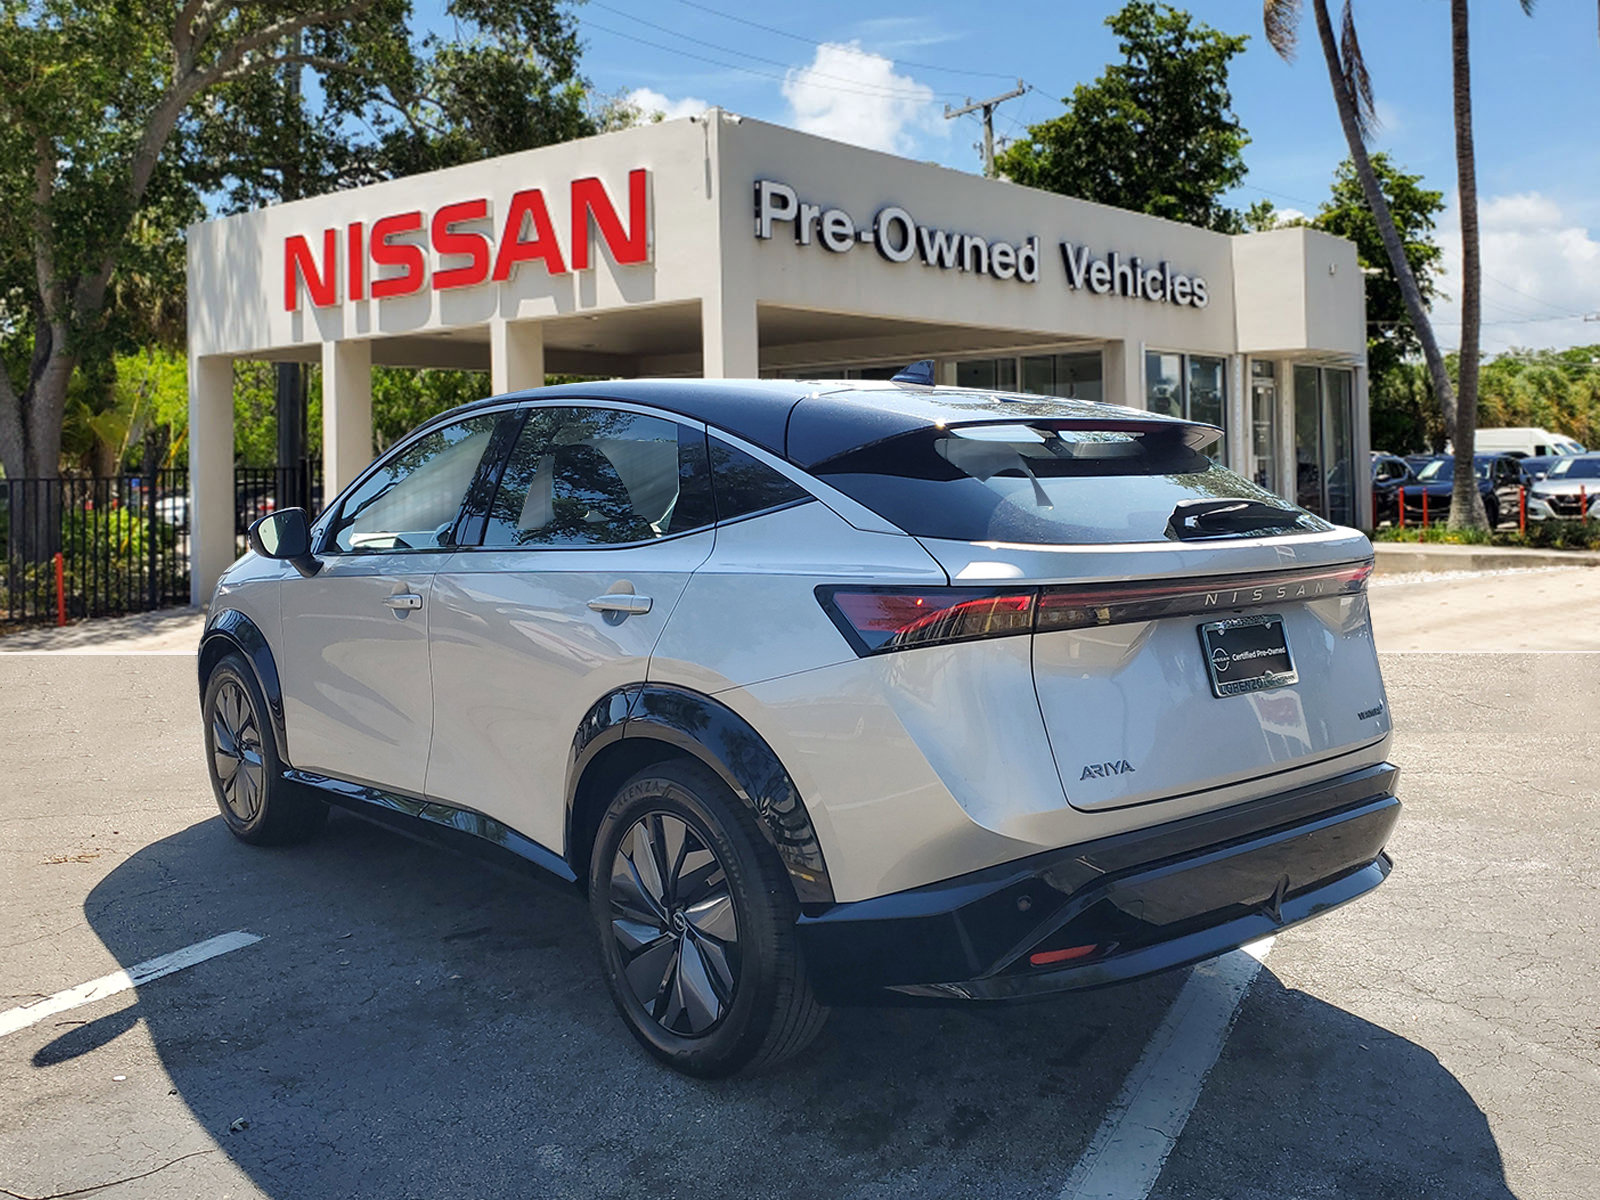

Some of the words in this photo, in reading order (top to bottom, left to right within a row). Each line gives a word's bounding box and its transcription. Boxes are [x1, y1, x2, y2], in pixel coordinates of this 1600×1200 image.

[285, 168, 648, 311] NISSAN
[754, 180, 1040, 284] Pre-Owned
[1061, 241, 1210, 308] Vehicles
[1204, 583, 1325, 606] NISSAN
[1231, 651, 1257, 662] Certified
[1256, 646, 1287, 657] Pre-Owned
[1079, 759, 1136, 781] ARIYA
